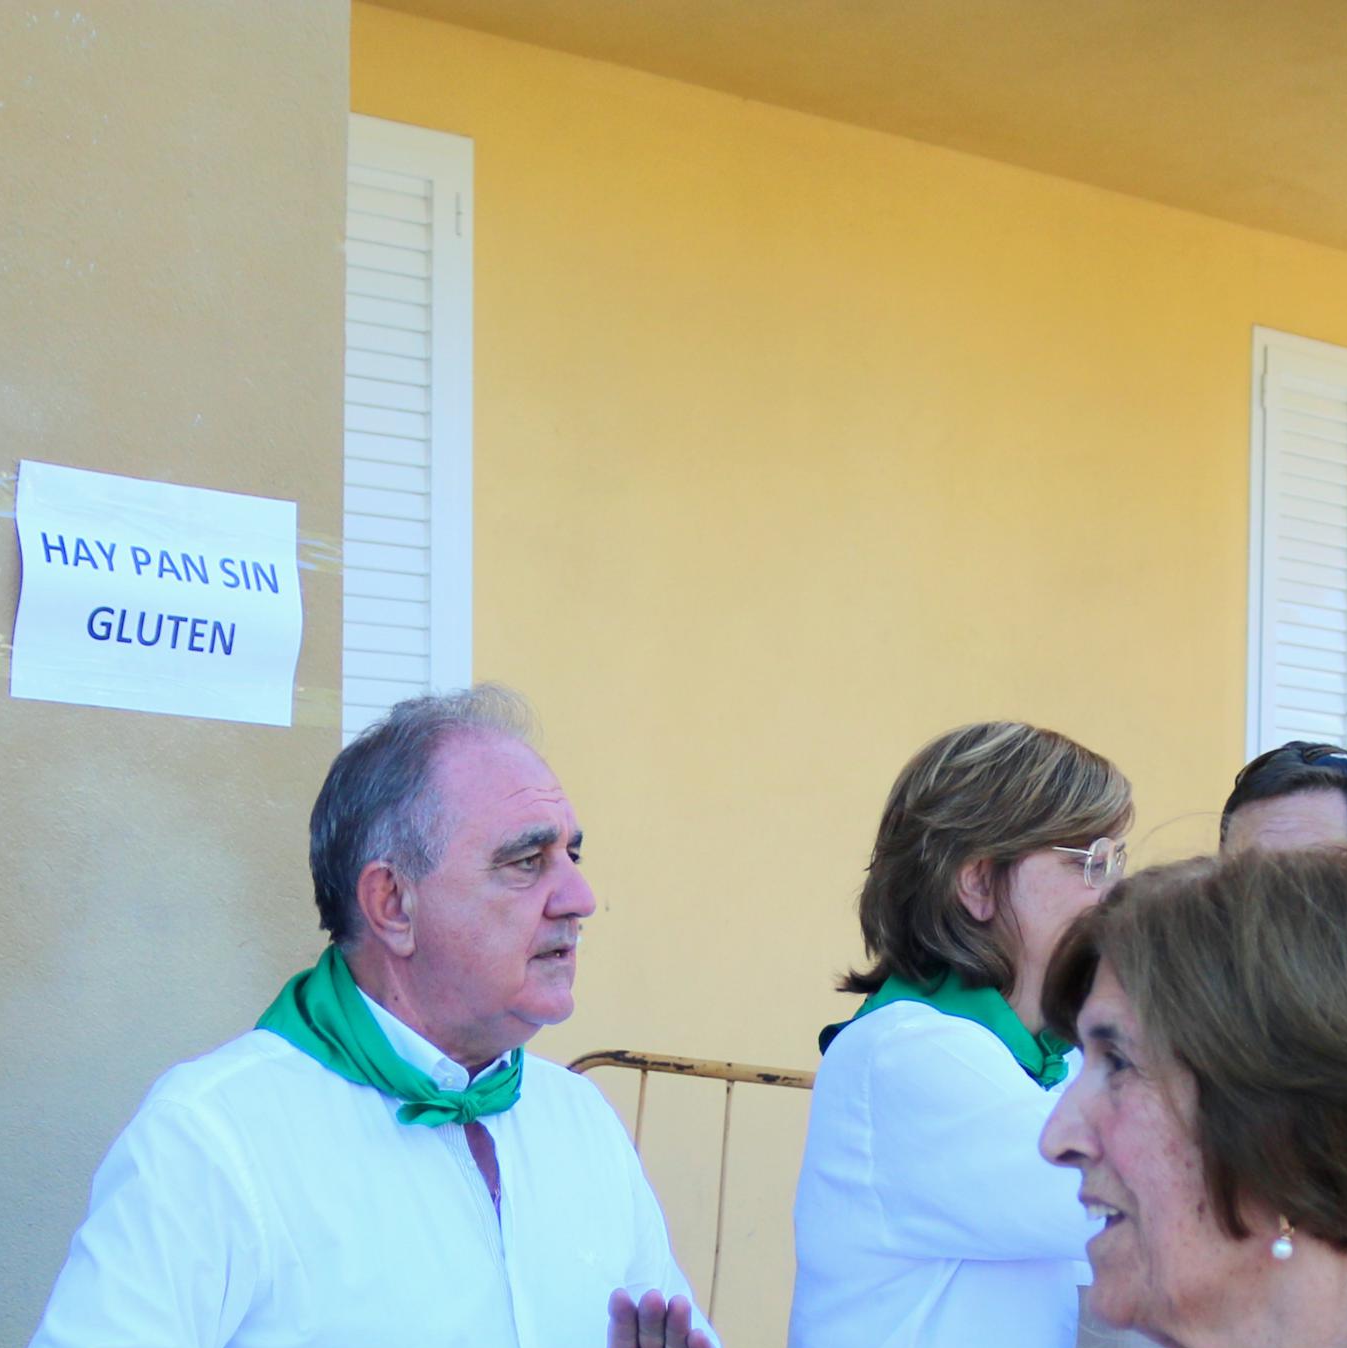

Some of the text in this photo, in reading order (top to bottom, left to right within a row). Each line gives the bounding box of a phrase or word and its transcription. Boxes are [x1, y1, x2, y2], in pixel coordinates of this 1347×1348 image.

[41, 532, 280, 595] HAY PAN SIN
[86, 605, 237, 656] GLUTEN
